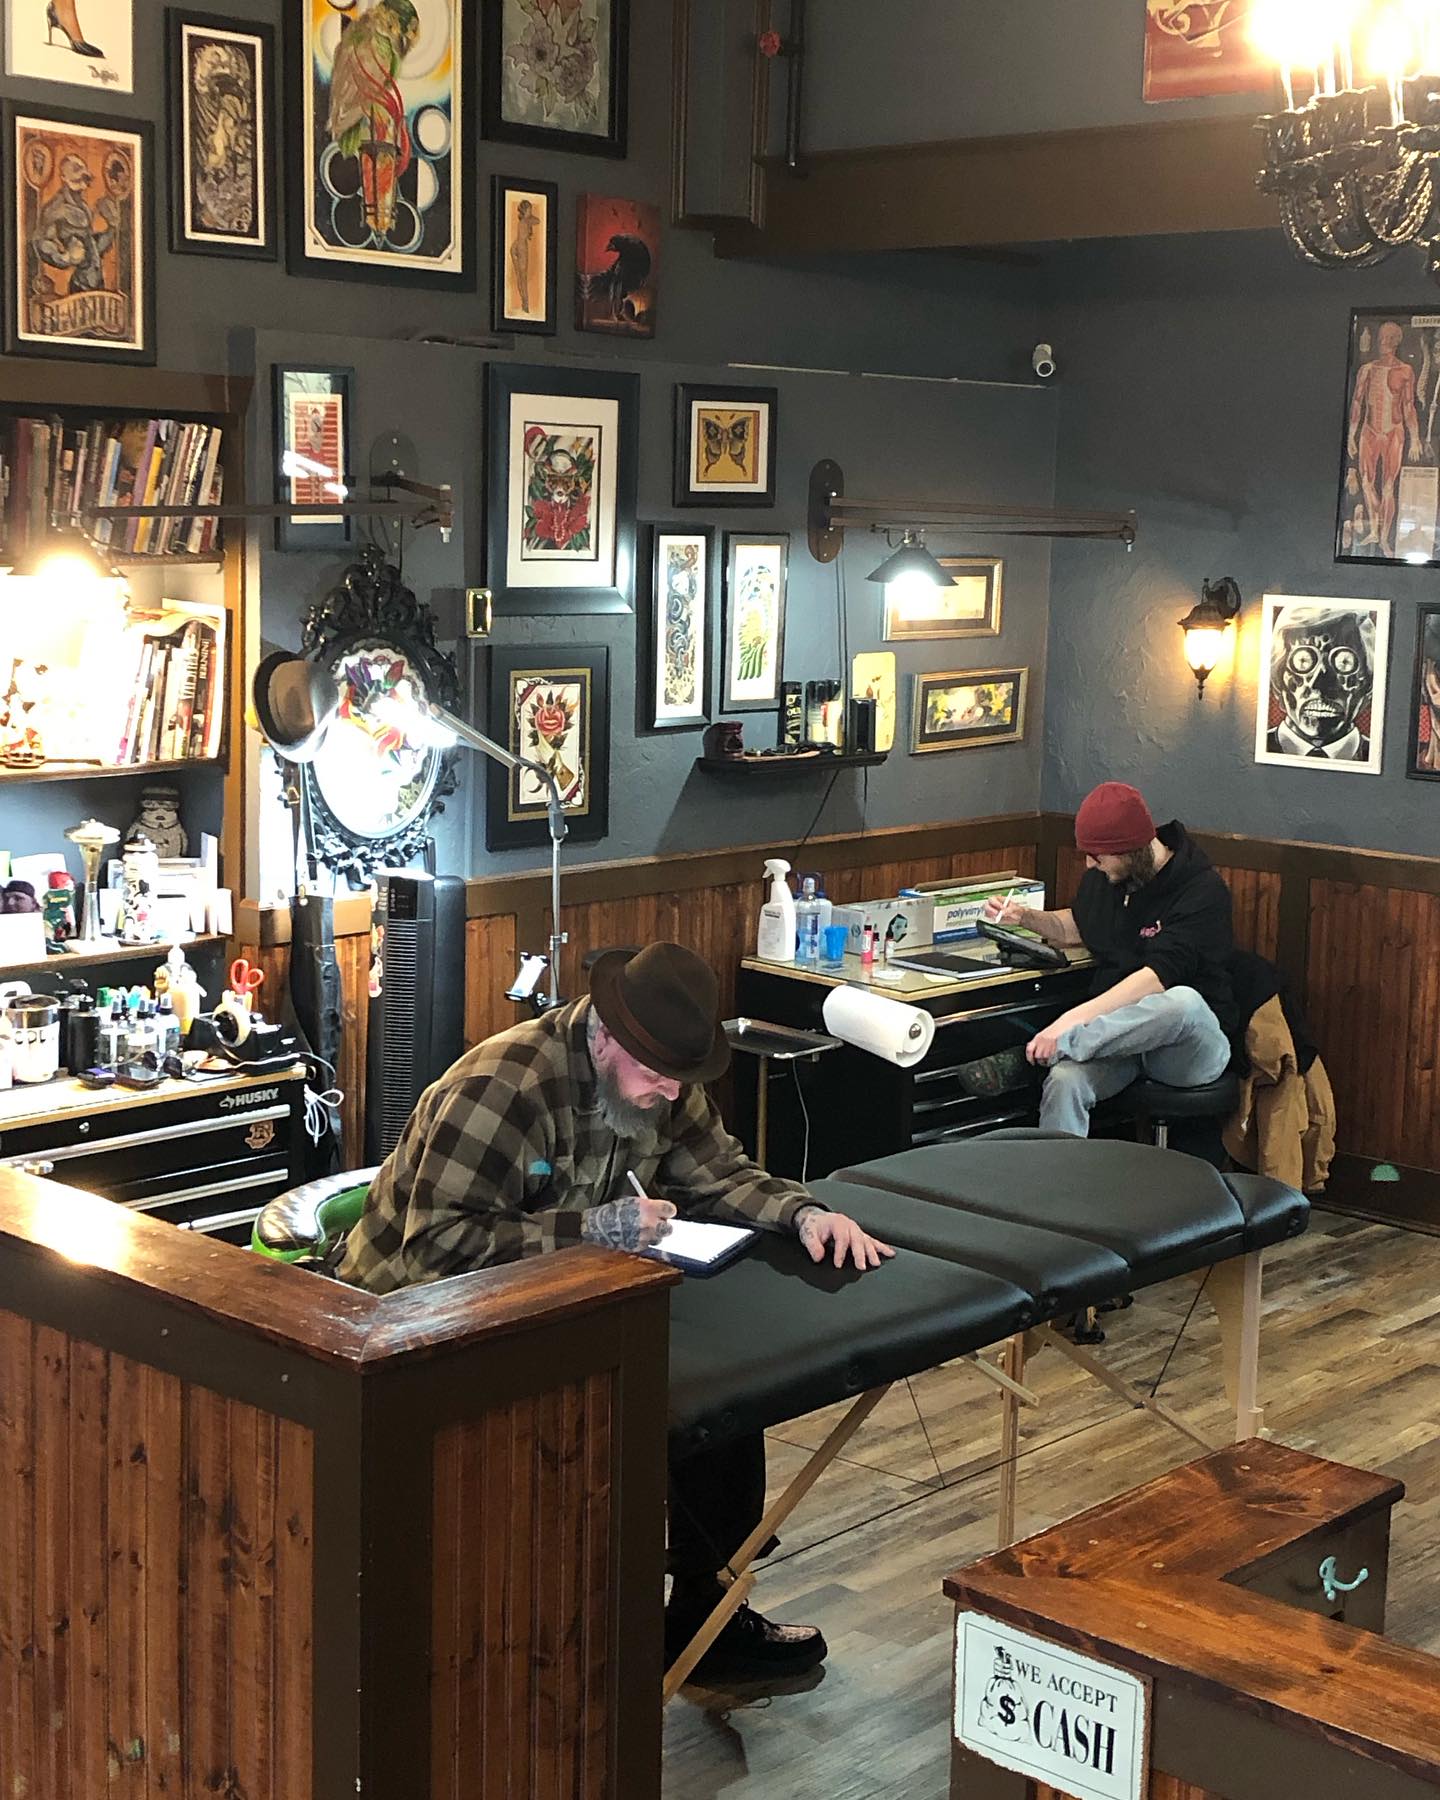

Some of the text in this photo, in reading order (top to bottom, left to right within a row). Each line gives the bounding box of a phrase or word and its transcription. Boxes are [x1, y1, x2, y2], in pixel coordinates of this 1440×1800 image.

[235, 1088, 279, 1106] HUSKY
[1016, 1659, 1118, 1713] WE ACCEPT
[1034, 1700, 1117, 1775] CASH
